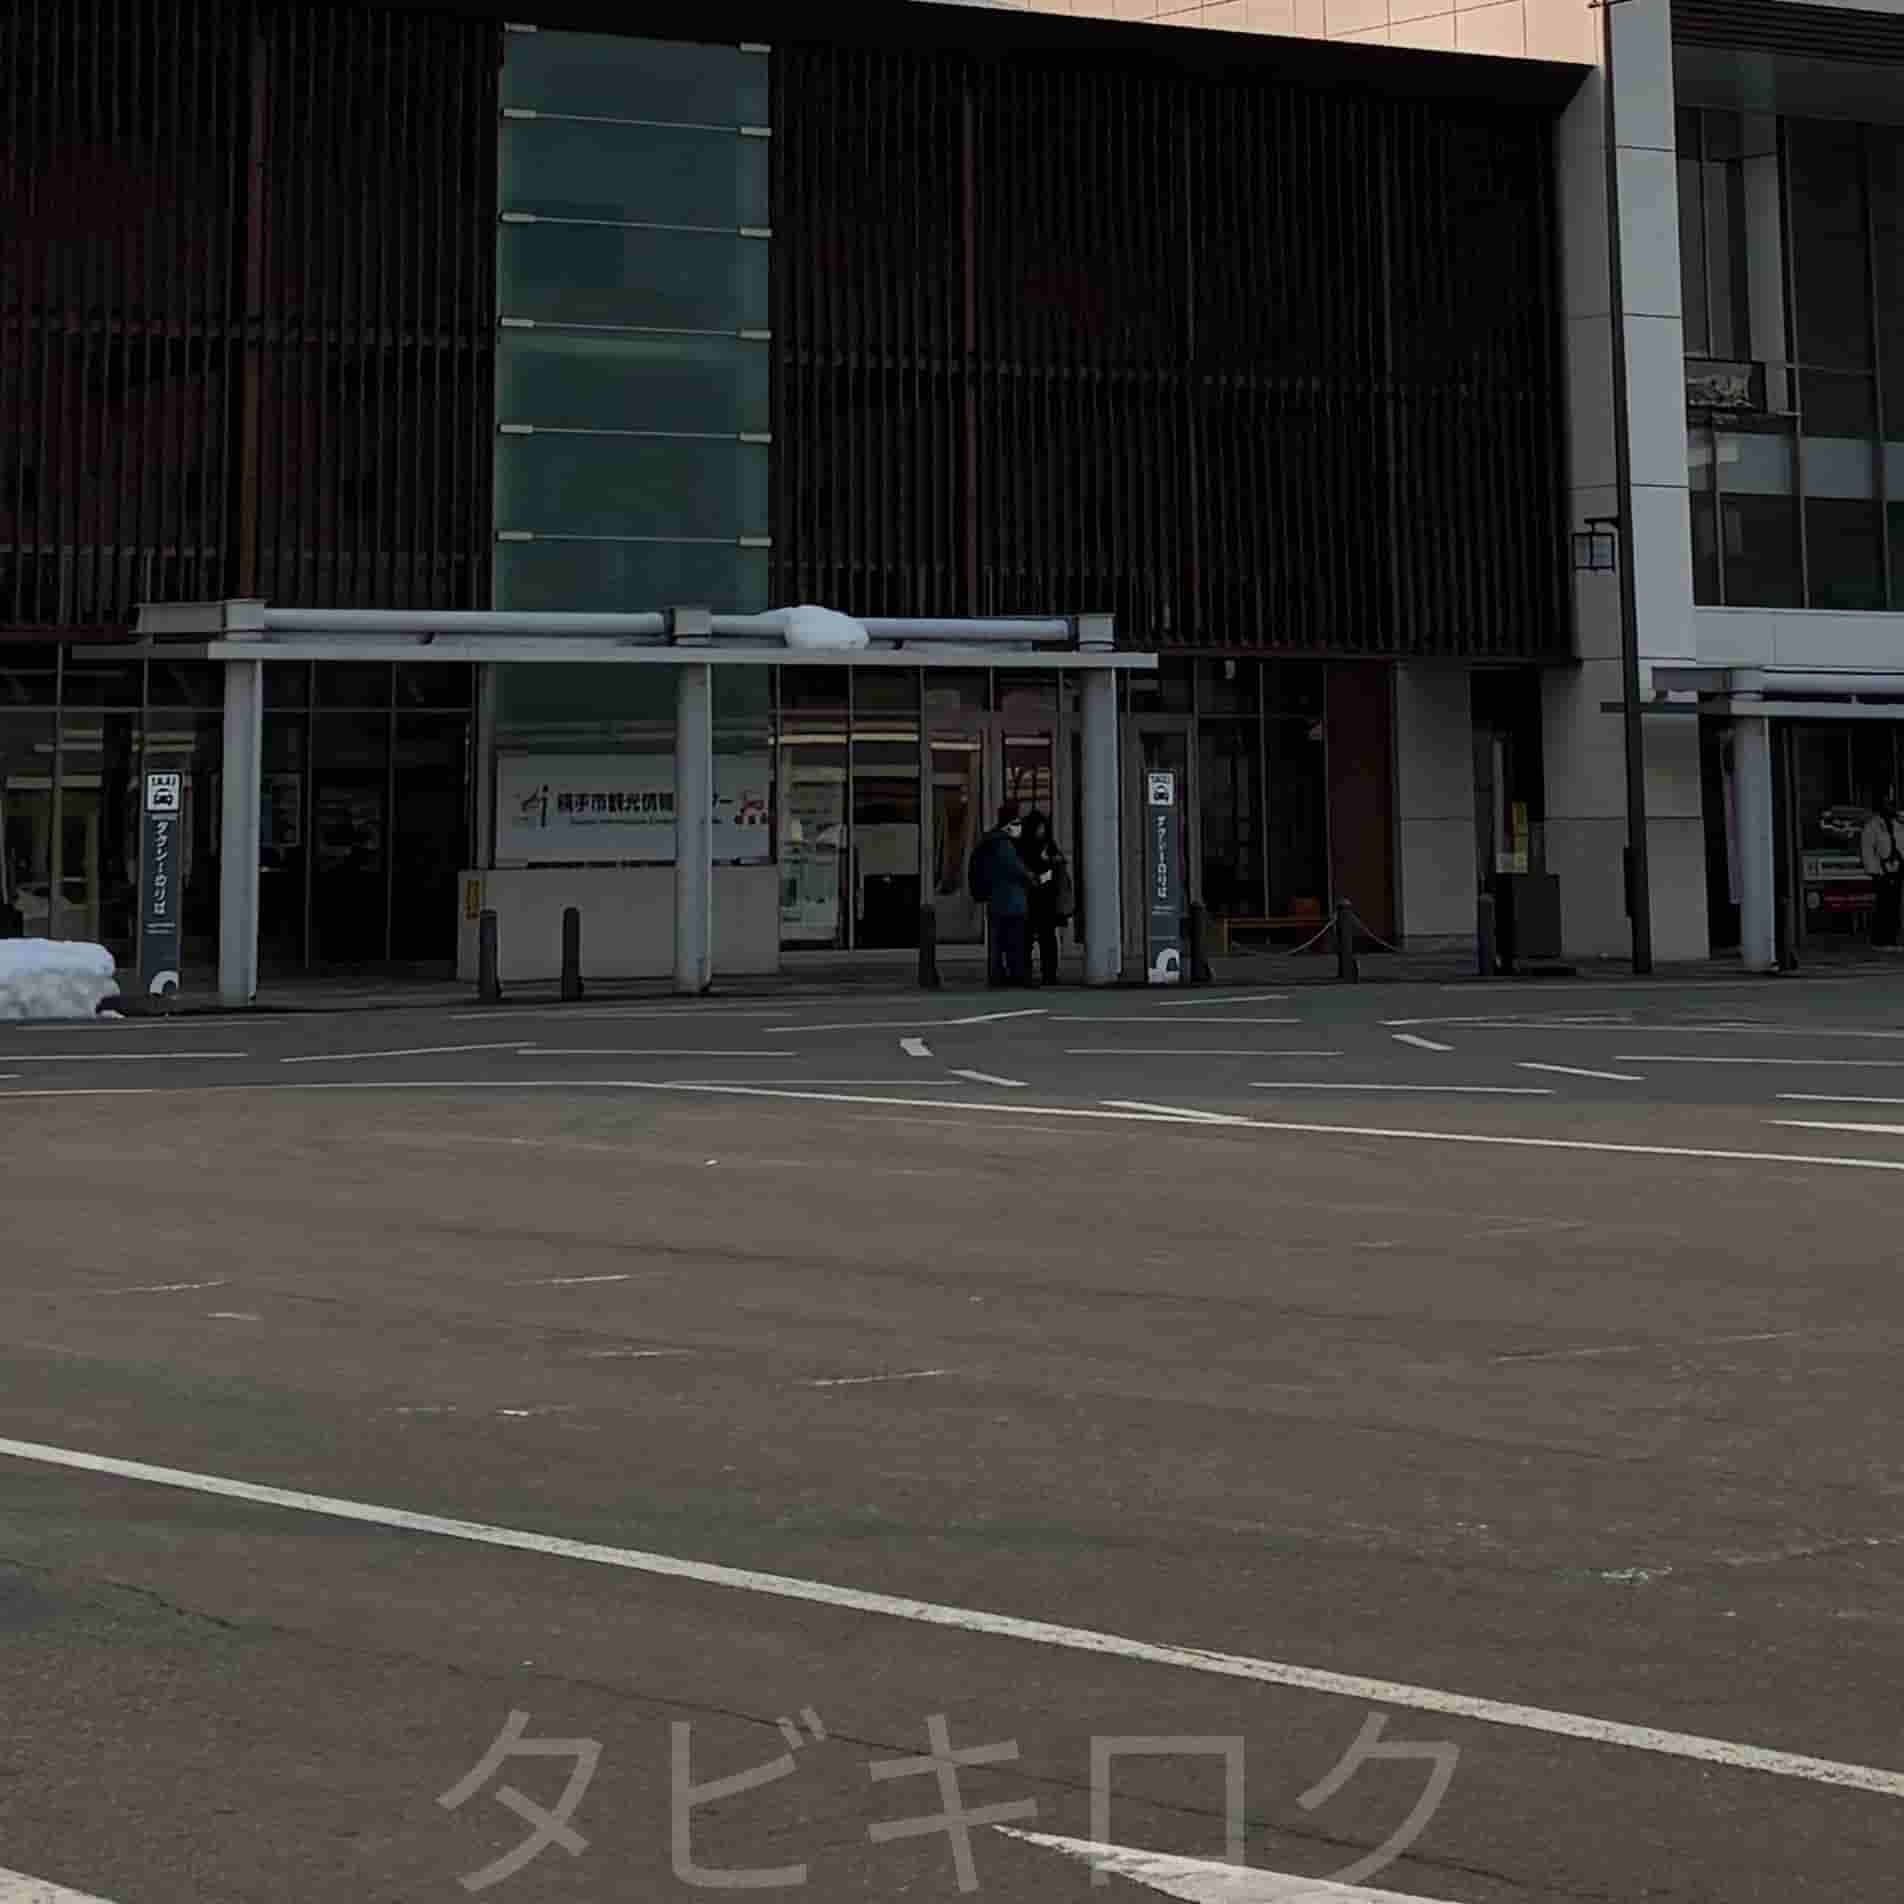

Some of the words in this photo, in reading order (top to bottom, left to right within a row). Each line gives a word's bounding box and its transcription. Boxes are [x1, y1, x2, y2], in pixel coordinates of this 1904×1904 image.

[153, 822, 169, 916] タクシーのりば
